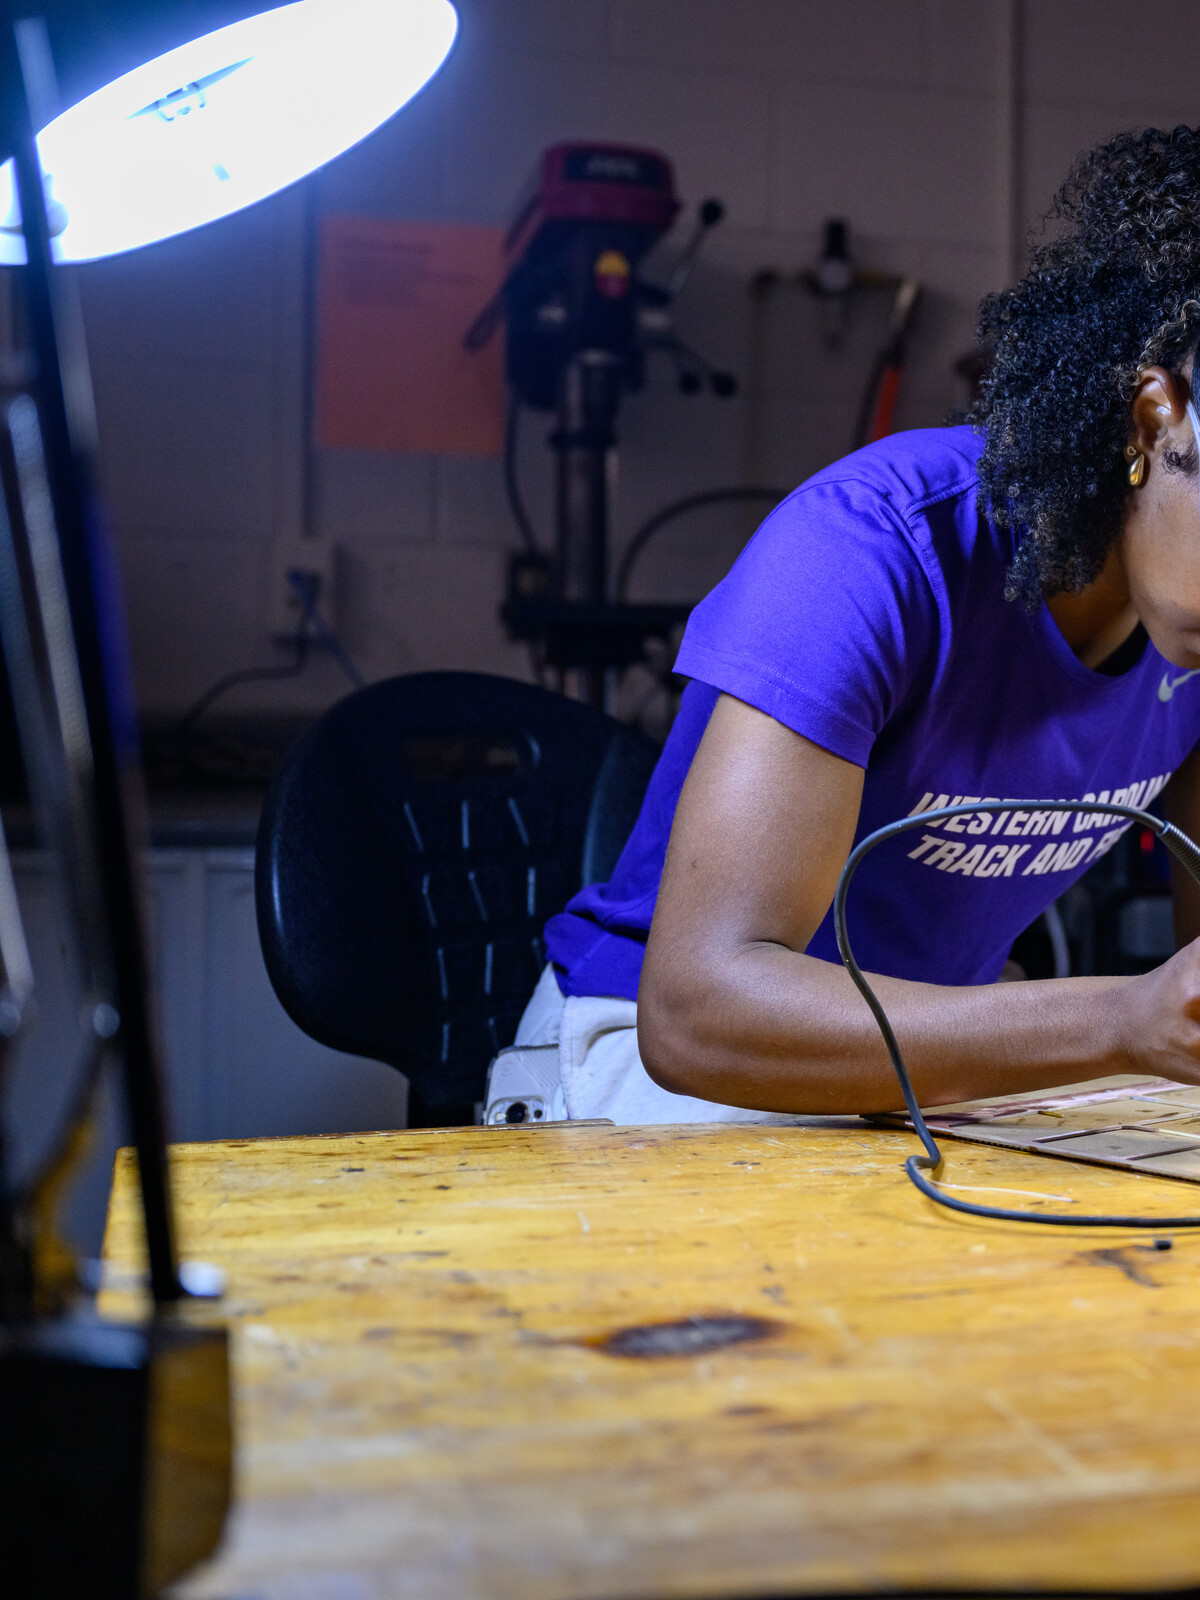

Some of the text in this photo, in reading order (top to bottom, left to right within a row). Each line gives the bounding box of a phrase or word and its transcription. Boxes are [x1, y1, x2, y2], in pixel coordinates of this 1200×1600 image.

[907, 792, 1078, 836] WESTERN
[907, 834, 1031, 878] TRACK
[1021, 837, 1094, 876] AND
